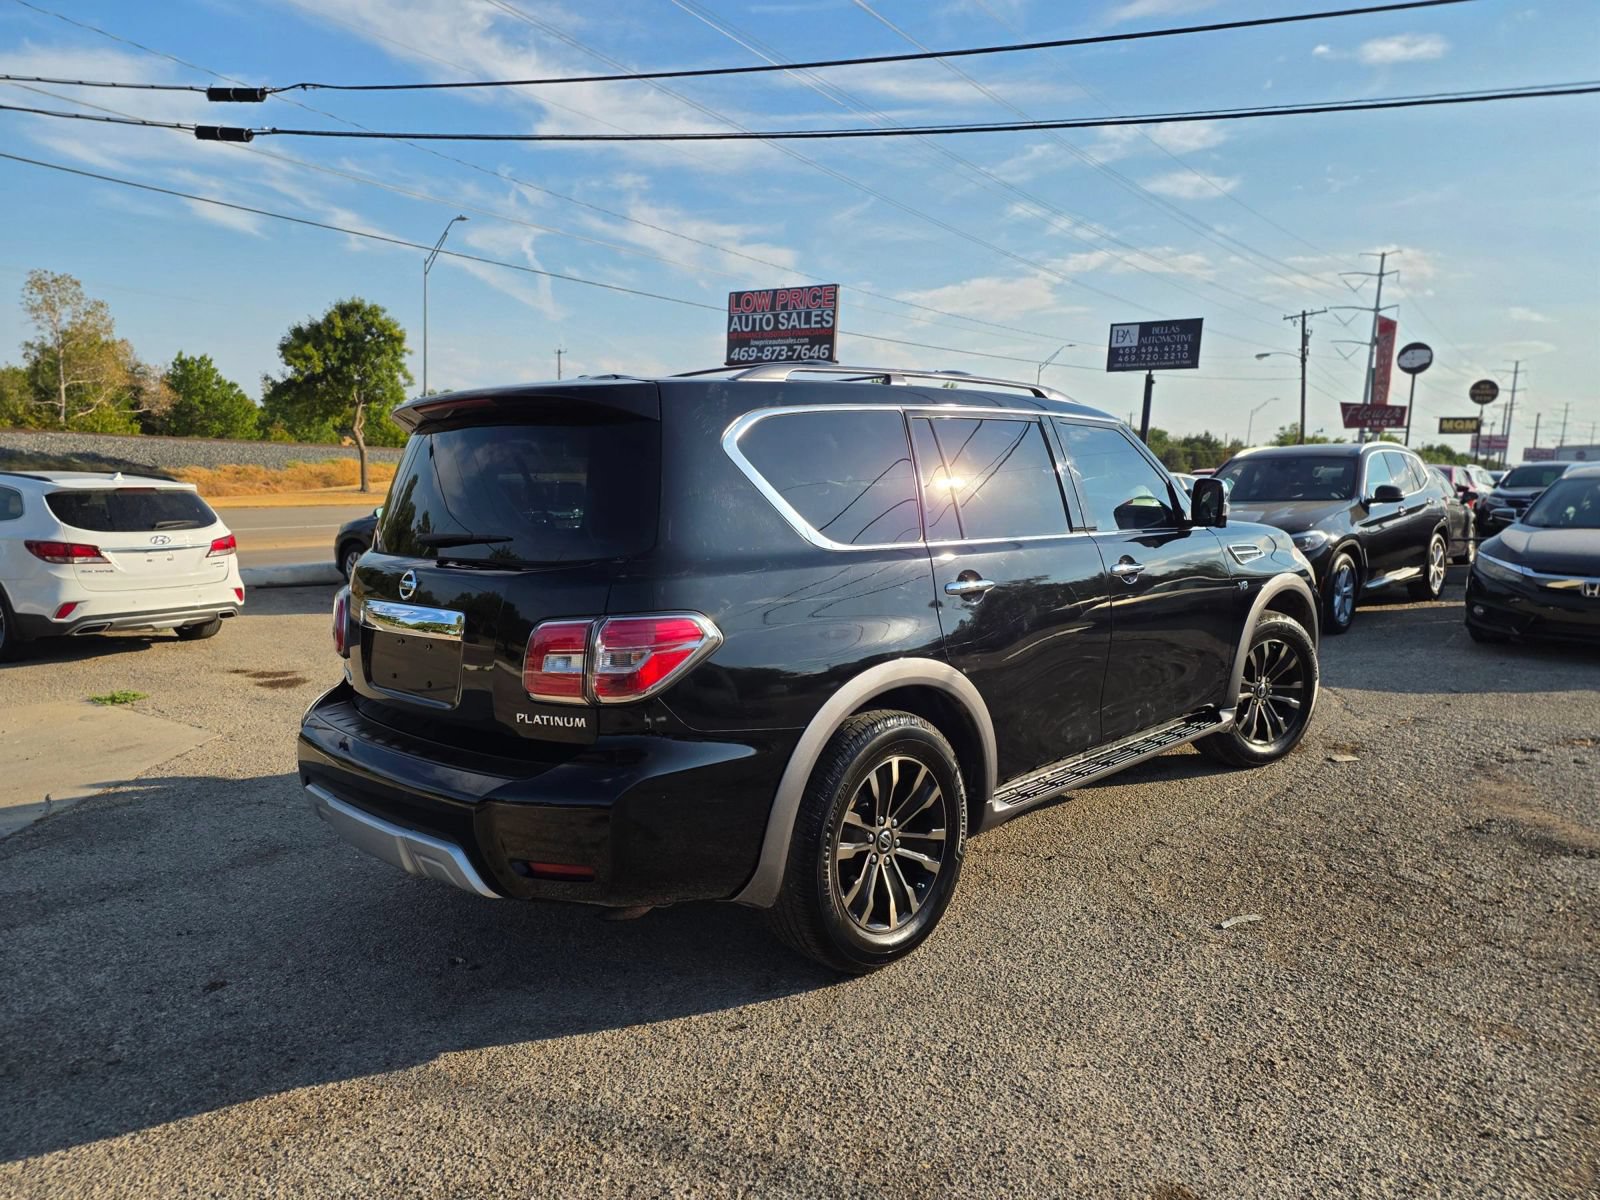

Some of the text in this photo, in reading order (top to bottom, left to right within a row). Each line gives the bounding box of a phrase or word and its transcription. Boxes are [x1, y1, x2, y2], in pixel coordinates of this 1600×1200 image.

[730, 286, 836, 314] LOW PRICE
[729, 310, 834, 332] AUTO SALES
[1139, 334, 1193, 344] AUTOMOTIVE
[730, 344, 830, 361] 469-873-7646
[1118, 352, 1189, 362] 469.720.2210
[516, 713, 586, 728] PLATINUM
